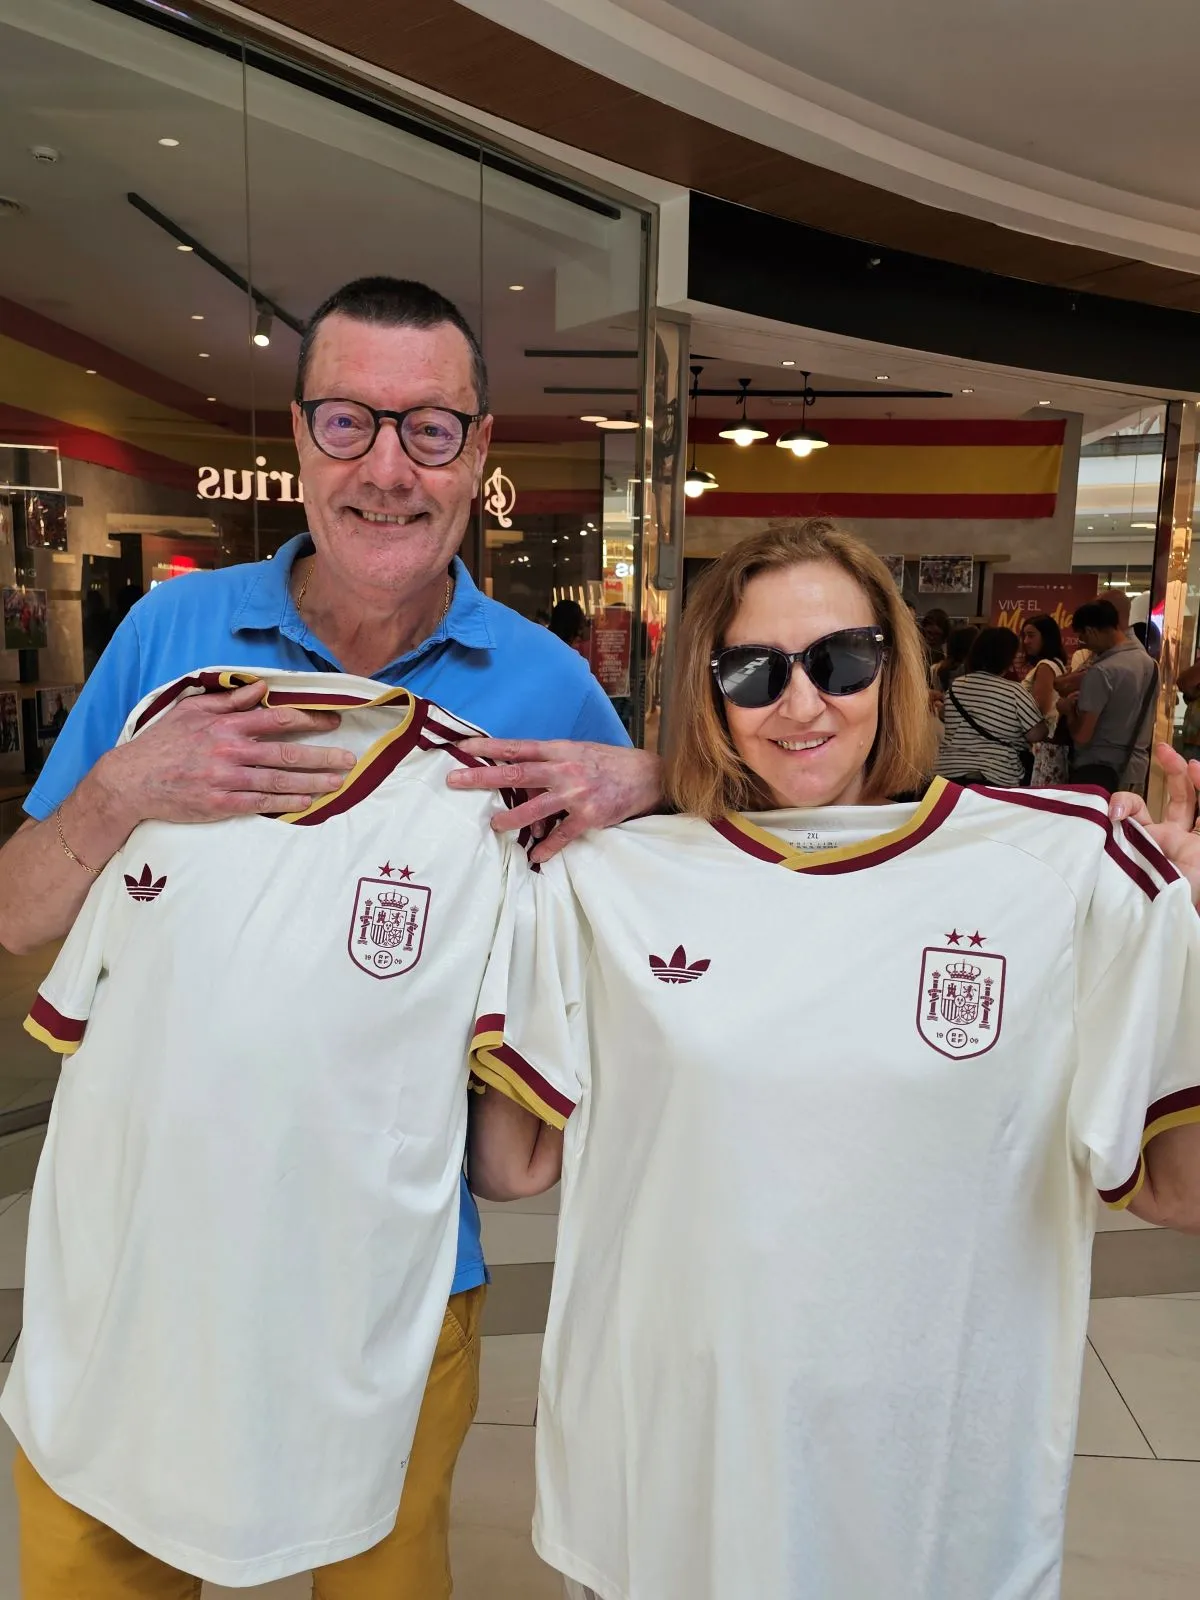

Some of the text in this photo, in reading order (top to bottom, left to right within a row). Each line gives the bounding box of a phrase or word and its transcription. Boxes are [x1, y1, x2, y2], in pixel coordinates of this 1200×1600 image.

[998, 599, 1041, 611] VIVE EL
[807, 832, 819, 840] 2XL
